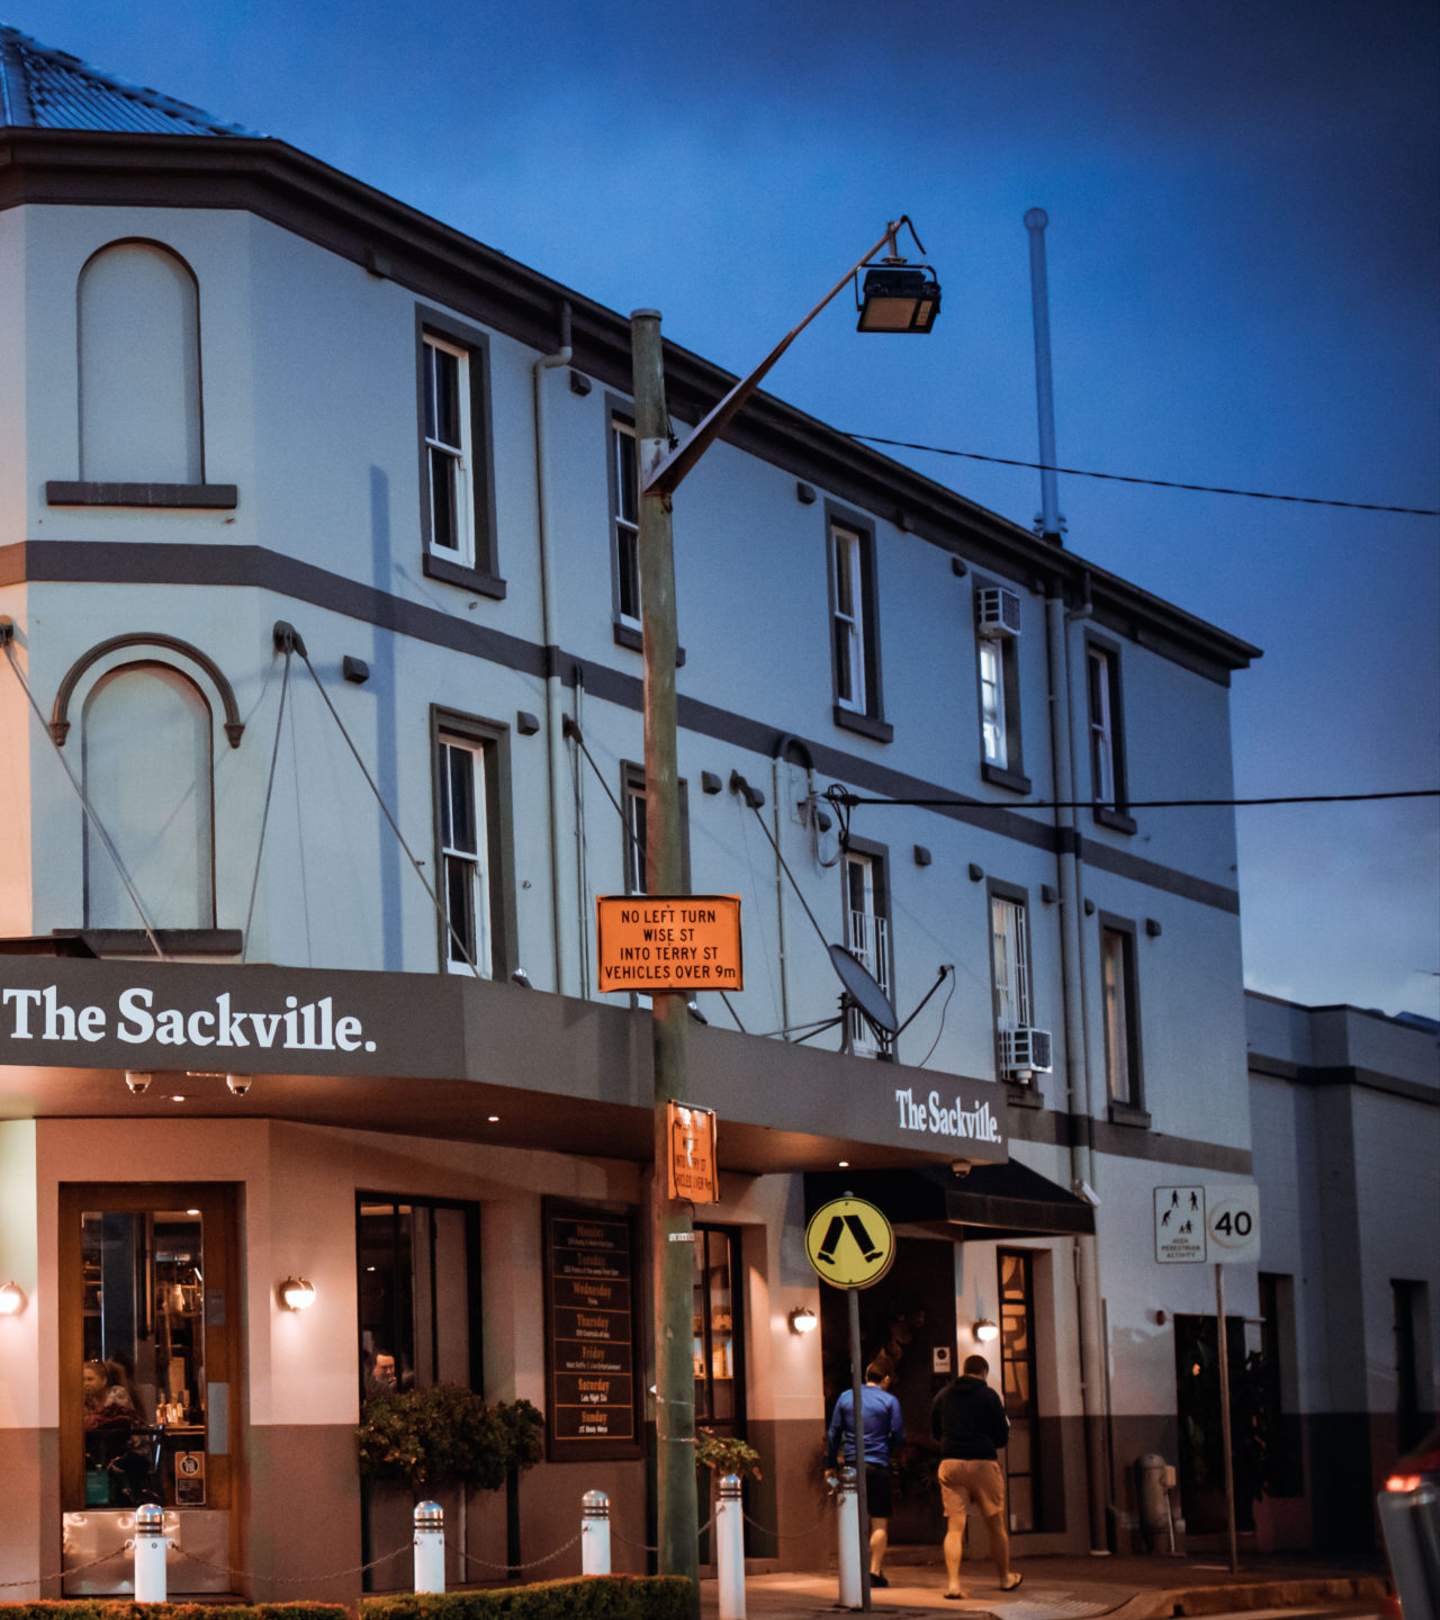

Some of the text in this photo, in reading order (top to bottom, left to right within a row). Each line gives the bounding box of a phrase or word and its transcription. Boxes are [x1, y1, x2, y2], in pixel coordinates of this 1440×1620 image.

[621, 910, 716, 923] NO LEFT TURN
[643, 928, 695, 941] WISE ST
[620, 946, 718, 960] INTO TERRY ST
[605, 965, 736, 979] VEHICLES OVER 9m
[2, 985, 377, 1052] The Sackville.
[896, 1087, 1003, 1145] The Sackville.
[1213, 1210, 1253, 1237] 40
